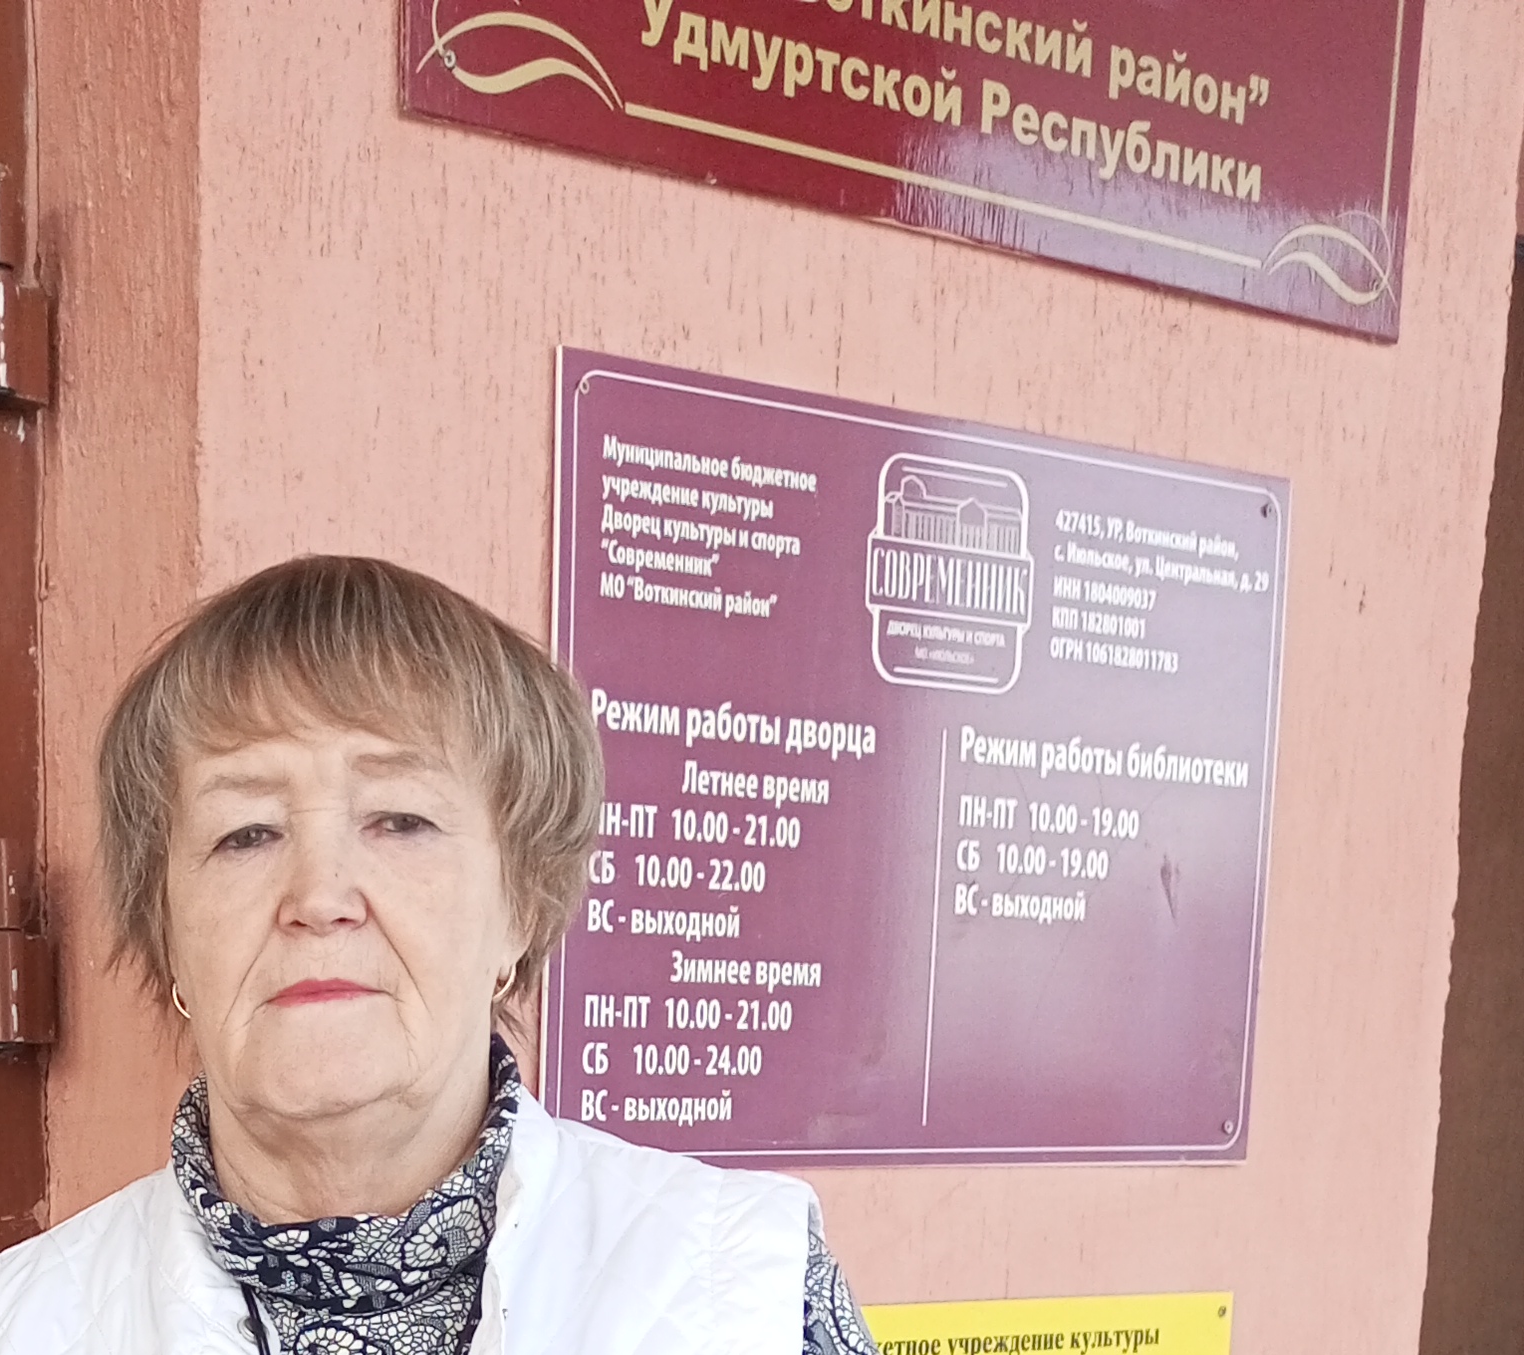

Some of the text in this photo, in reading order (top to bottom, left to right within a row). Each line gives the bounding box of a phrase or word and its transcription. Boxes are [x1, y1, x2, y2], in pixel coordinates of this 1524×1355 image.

[641, 0, 1261, 202] Удмуртской Республики
[1109, 45, 1269, 125] район”
[603, 434, 817, 492] Муниципальное бюджетное
[602, 475, 774, 521] учреждение культуры
[601, 504, 800, 559] Дворец культуры и спорта
[1055, 509, 1105, 539] 427415,
[1125, 520, 1197, 552] Воткинский
[1198, 534, 1239, 561] район,
[600, 572, 625, 598] МО
[872, 547, 1028, 615] СОВРЕМЕННИК
[1053, 575, 1157, 611] ИНН 1804009037
[1254, 570, 1270, 592] 29
[1052, 605, 1146, 640] КПП 182801001
[1050, 636, 1083, 661] ОГРН
[591, 688, 876, 760] Режим работы дворца
[960, 725, 1249, 788] Режим работы библиотеки
[682, 760, 829, 809] Летнее время
[671, 808, 729, 844] 10.00
[744, 814, 801, 849] 21.00
[958, 794, 1018, 830] ПН-ПТ
[1029, 802, 1077, 834] 10.00
[1092, 807, 1140, 840] 19.00
[588, 850, 616, 885] СБ
[635, 854, 692, 889] 10.00
[708, 859, 766, 893] 22.00
[957, 839, 980, 872] СБ
[997, 843, 1046, 875] 10.00
[1061, 848, 1109, 880] 19.00
[587, 899, 614, 933] ВС
[631, 905, 740, 942] выходной
[954, 883, 979, 916] ВС
[991, 891, 1086, 925] выходной
[670, 950, 822, 993] Зимнее время
[583, 994, 651, 1028] ПН-ПТ
[664, 998, 721, 1030] 10.00
[736, 1000, 793, 1031] 21.00
[581, 1042, 609, 1076] СБ
[632, 1044, 690, 1076] 10.00
[705, 1045, 763, 1076] 24.00
[581, 1089, 607, 1122] ВС
[623, 1089, 733, 1126] выходной
[1070, 1328, 1160, 1355] культуры
